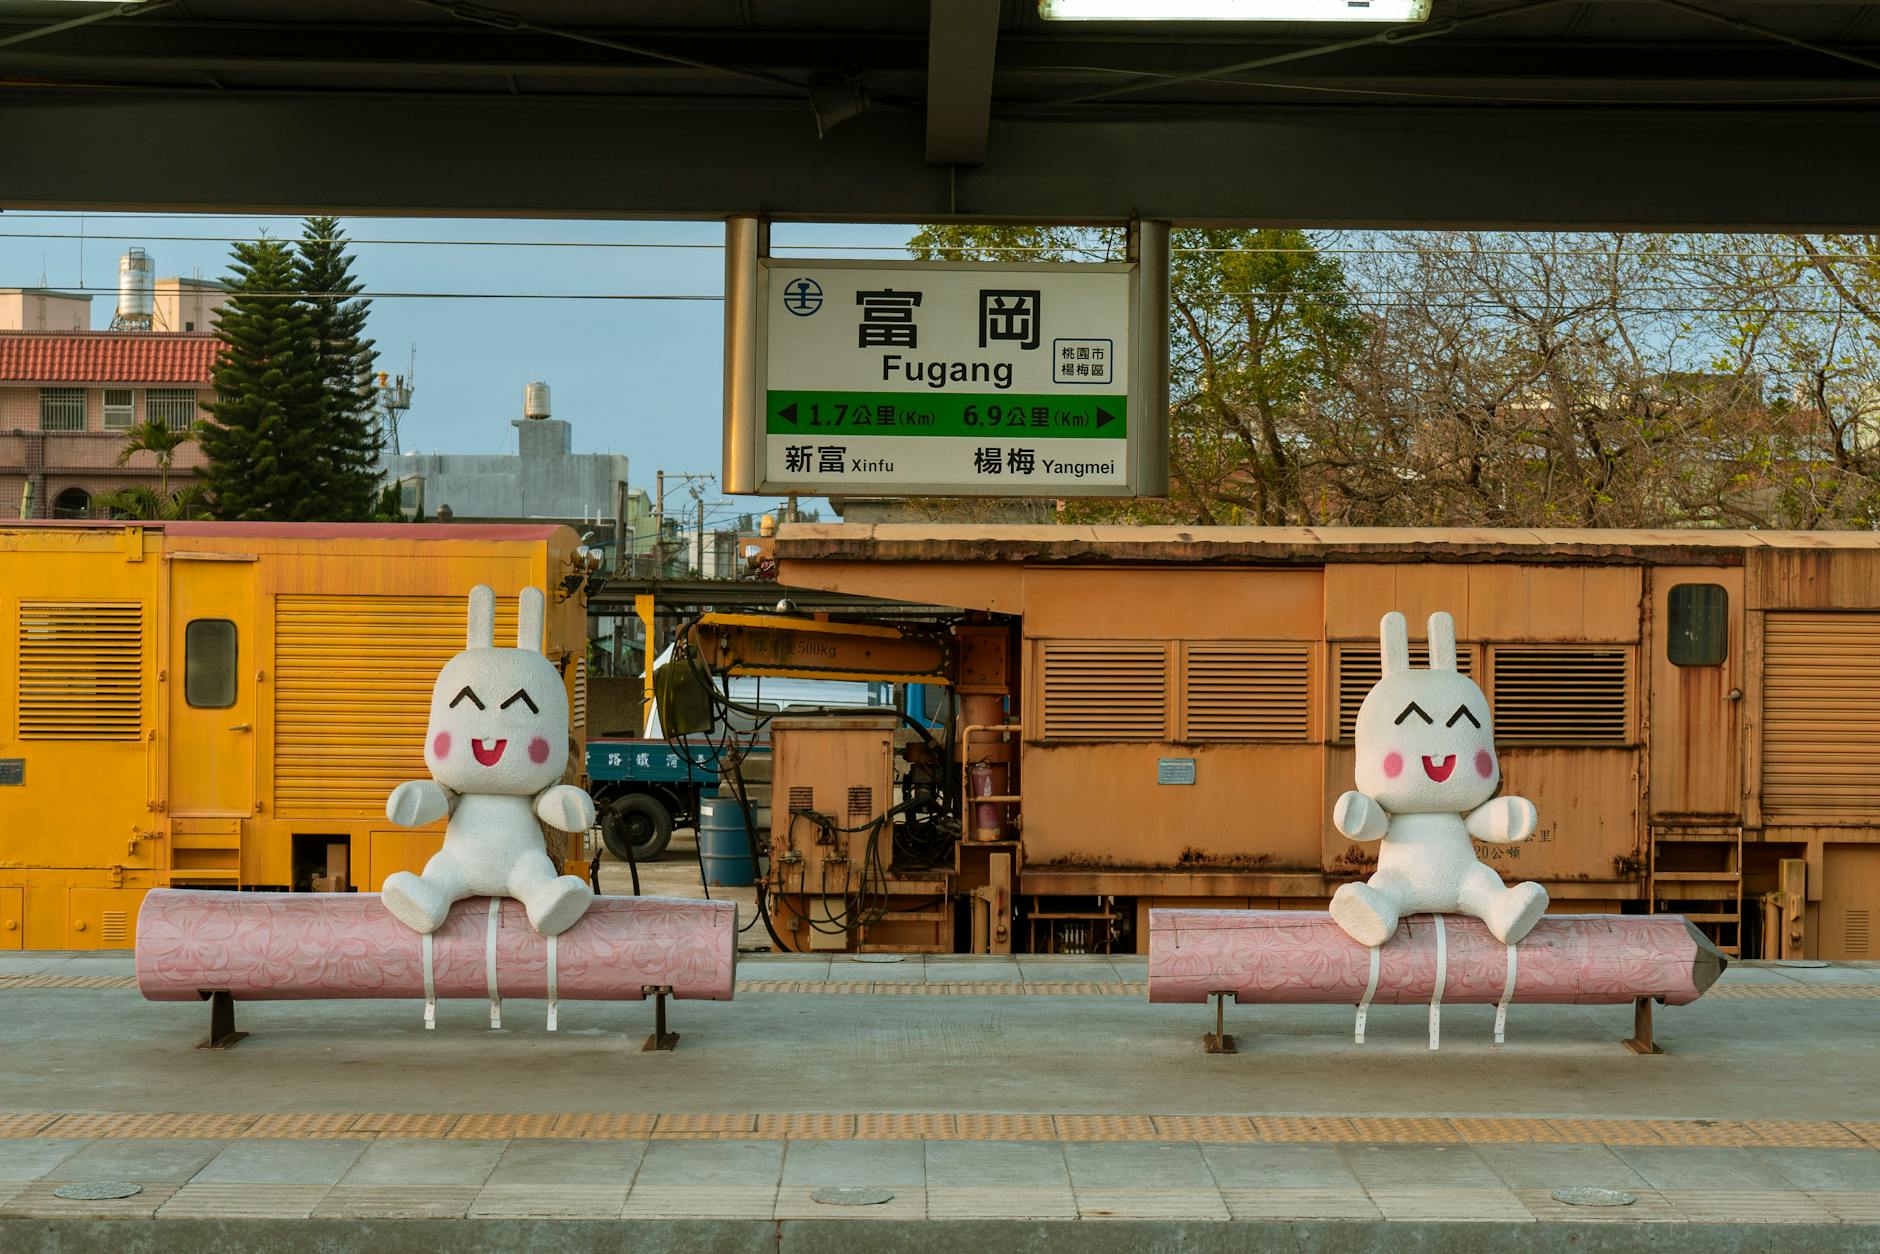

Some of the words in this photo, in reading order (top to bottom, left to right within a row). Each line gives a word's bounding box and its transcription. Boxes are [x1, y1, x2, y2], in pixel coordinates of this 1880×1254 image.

[855, 288, 1041, 351] 富岡
[1061, 346, 1104, 360] 桃園市
[882, 355, 1014, 389] Fugang
[1061, 363, 1104, 377] 楊梅區
[785, 445, 847, 474] 新富
[851, 458, 895, 473] Xinfu
[974, 447, 1036, 475] 楊梅
[1041, 459, 1115, 478] Yangmei
